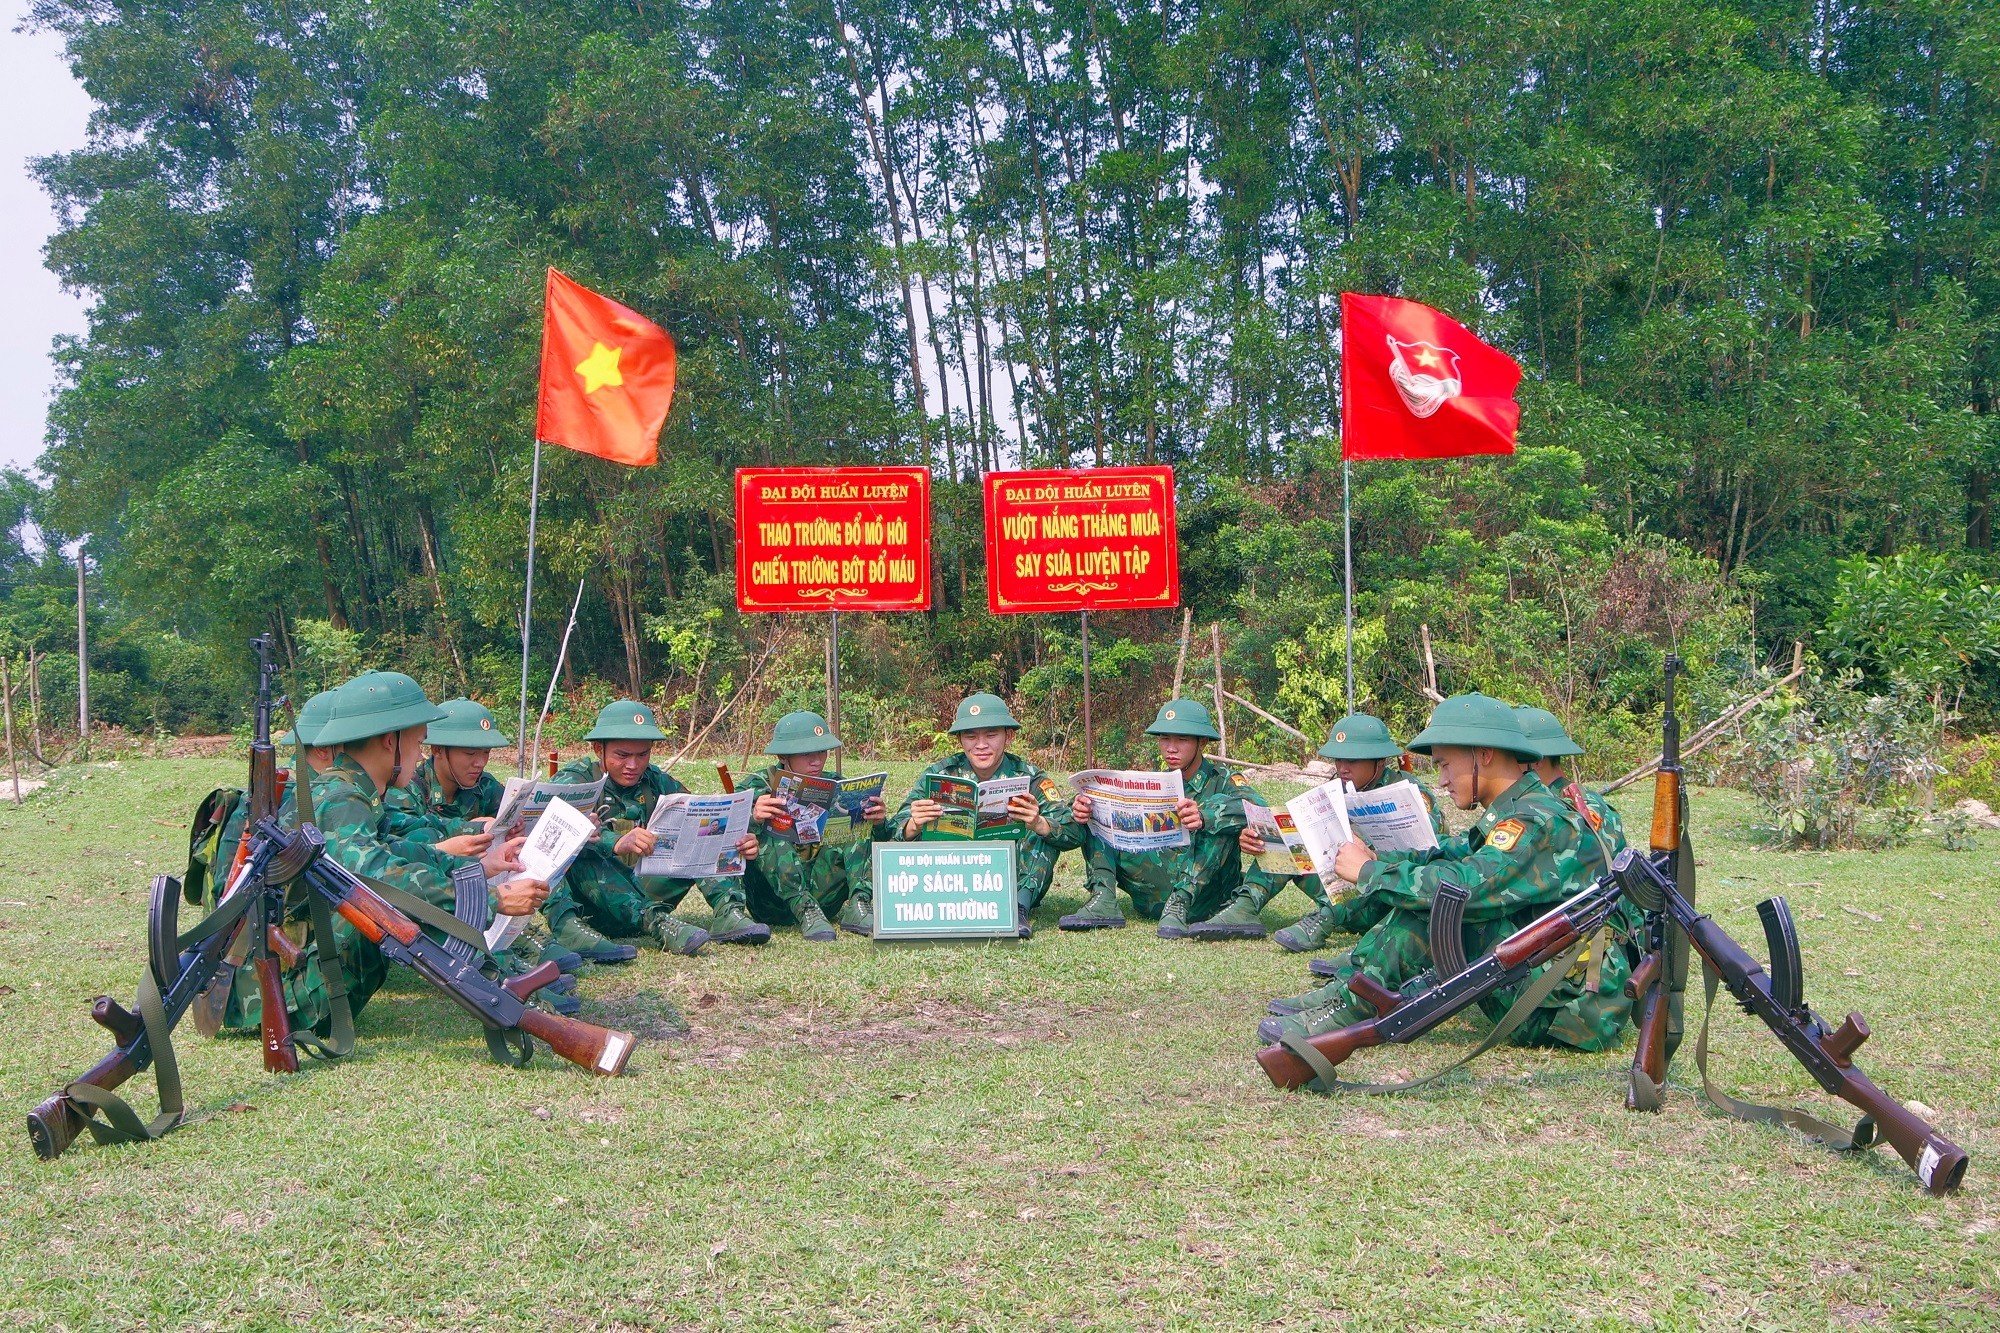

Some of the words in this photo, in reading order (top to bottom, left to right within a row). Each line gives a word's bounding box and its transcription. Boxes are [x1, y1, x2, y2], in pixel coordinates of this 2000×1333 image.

[762, 487, 786, 501] ĐẠI
[791, 484, 816, 501] ĐỘI
[820, 481, 858, 498] HUẤN
[864, 483, 908, 500] LUYỆN
[1006, 488, 1030, 502] ĐẠI
[1035, 484, 1059, 501] ĐỘI
[1064, 481, 1102, 498] HUẤN
[759, 522, 791, 546] THAO
[794, 517, 842, 546] TRƯỜNG
[845, 512, 862, 546] ĐỔ
[865, 514, 883, 545] MỒ
[887, 516, 908, 545] HÔI
[1003, 512, 1037, 545] VƯỢT
[1042, 506, 1078, 538] NẮNG
[1082, 503, 1127, 537] THẮNG
[1131, 508, 1160, 536] MƯA
[752, 554, 788, 585] CHIẾN
[791, 555, 838, 584] TRƯỜNG
[842, 555, 865, 584] BỚT
[869, 550, 887, 584] ĐỔ
[890, 554, 915, 583] MÁU
[1015, 554, 1041, 577] SAY
[1046, 549, 1072, 576] SƯA
[1076, 546, 1120, 580] LUYỆN
[1124, 544, 1150, 579] TẬP
[841, 776, 881, 791] VIETNAM
[935, 852, 960, 865] HUẤN
[963, 853, 992, 866] LUYỆN
[888, 871, 918, 896] HỘP
[923, 871, 968, 894] SÁCH,
[973, 870, 1003, 892] BÁO
[895, 903, 934, 921] THAO
[938, 898, 998, 920] TRƯỜNG
